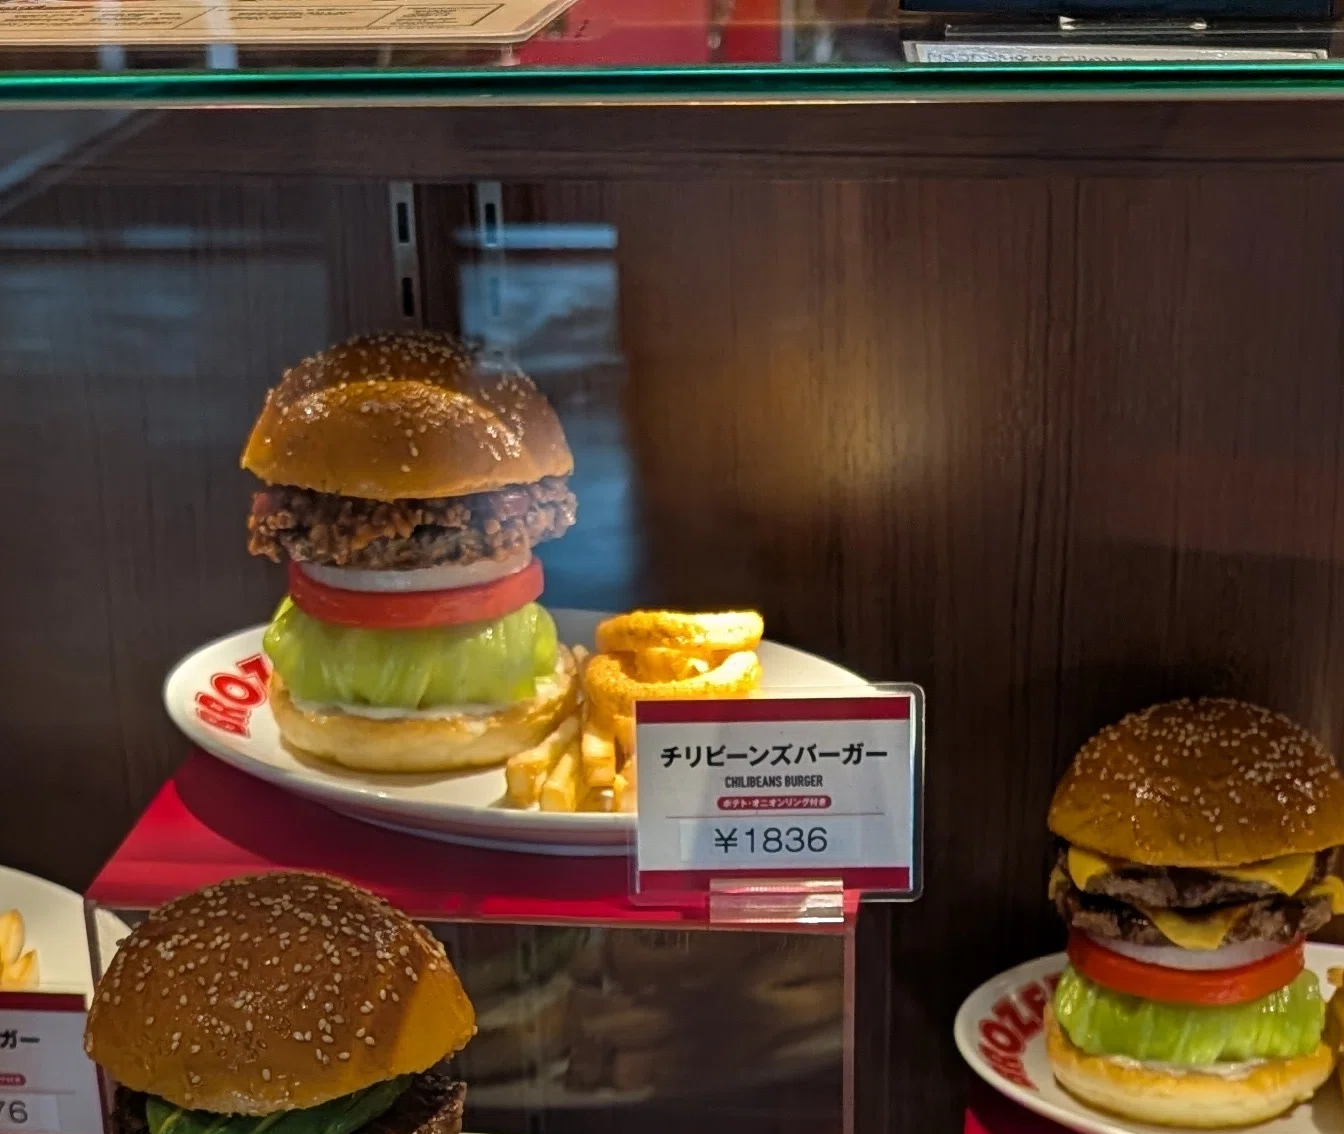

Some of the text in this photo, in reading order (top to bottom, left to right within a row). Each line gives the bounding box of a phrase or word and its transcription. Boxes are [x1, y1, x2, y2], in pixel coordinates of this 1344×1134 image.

[660, 742, 889, 769] チリビーンズバーガー
[724, 774, 824, 789] CHILIBEANS BURGER
[714, 826, 829, 854] ¥1836
